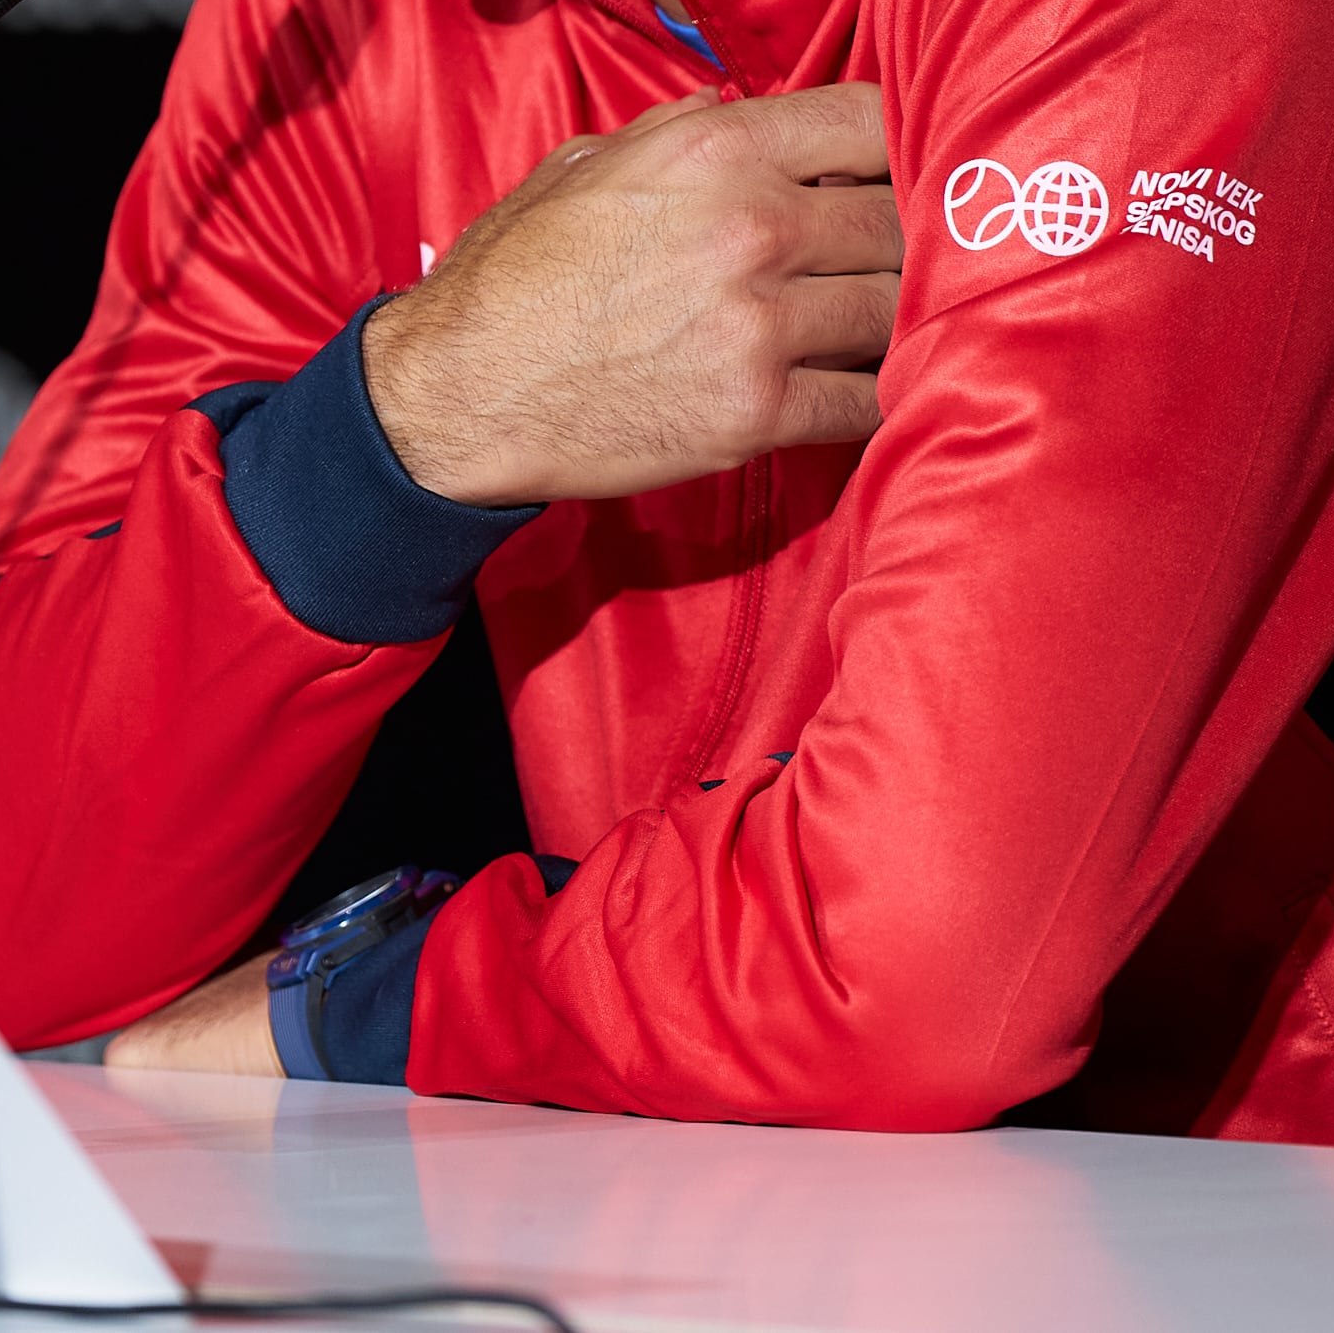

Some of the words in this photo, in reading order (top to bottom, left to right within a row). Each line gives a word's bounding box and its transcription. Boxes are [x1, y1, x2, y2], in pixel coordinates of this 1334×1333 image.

[1129, 168, 1213, 197] NOVI
[1215, 170, 1264, 217] VEK
[1119, 214, 1214, 263] ENISA
